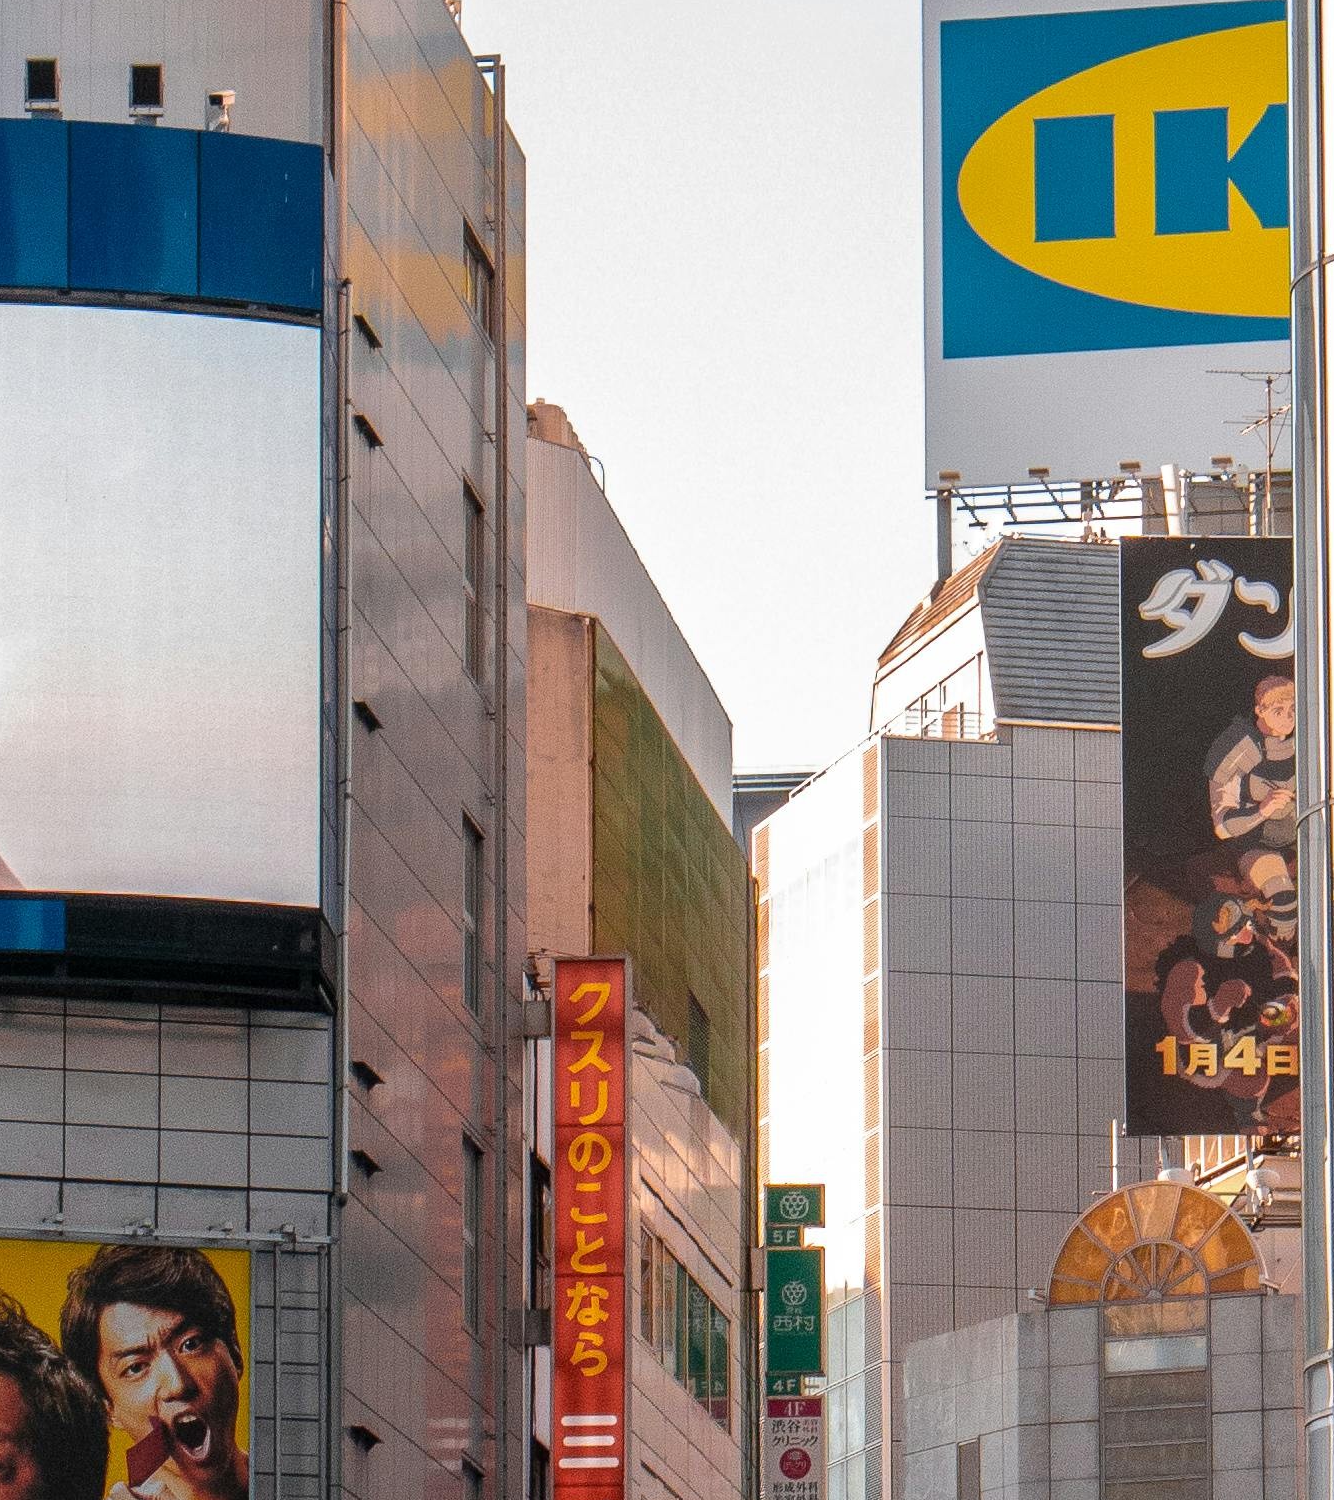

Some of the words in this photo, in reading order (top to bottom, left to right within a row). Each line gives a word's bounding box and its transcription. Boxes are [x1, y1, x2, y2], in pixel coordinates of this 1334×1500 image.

[1155, 1034, 1298, 1077] 1月4日
[565, 981, 613, 1378] クスリのことなら
[772, 1229, 797, 1244] 5F
[772, 1314, 816, 1332] 西村
[772, 1377, 798, 1394] 4F
[783, 1401, 806, 1417] 4F
[771, 1435, 819, 1447] クリニック
